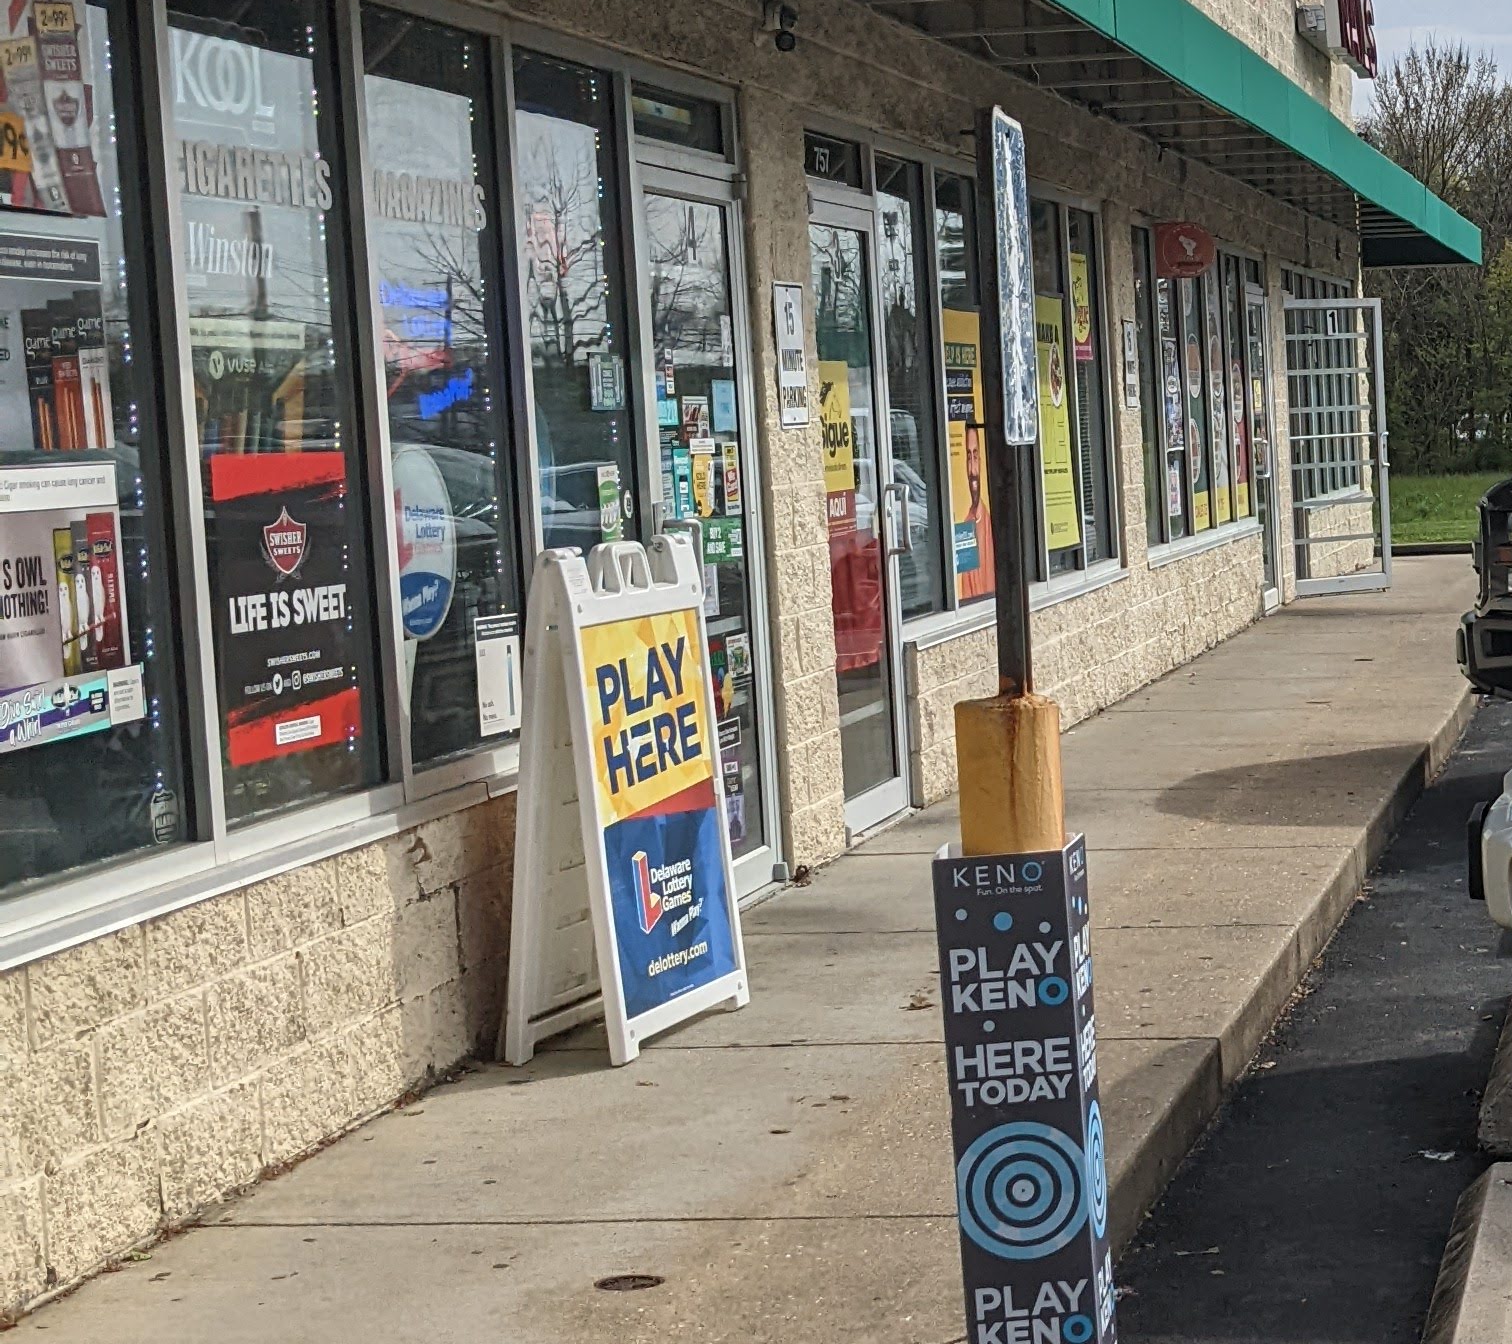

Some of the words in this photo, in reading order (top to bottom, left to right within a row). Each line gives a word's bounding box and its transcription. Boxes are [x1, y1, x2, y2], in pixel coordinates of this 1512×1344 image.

[172, 29, 275, 116] KOOL
[0, 122, 29, 159] 9¢
[814, 146, 830, 173] 757
[187, 222, 273, 278] Winston
[77, 317, 101, 337] game
[784, 301, 794, 335] 15
[26, 337, 50, 360] game
[52, 327, 76, 350] game
[782, 349, 804, 372] MINUTE
[783, 385, 807, 409] PARKING
[405, 504, 445, 523] Delaware
[829, 491, 847, 518] AQUÍ
[269, 531, 303, 547] SWISHER
[416, 523, 445, 542] Lottery
[273, 546, 301, 556] SWEETS
[15, 556, 47, 588] OWL
[0, 590, 49, 619] OTHING!
[229, 593, 268, 634] LIFE
[270, 590, 290, 628] IS
[293, 583, 346, 625] SWEET
[596, 635, 686, 726] PLAY
[604, 700, 702, 795] HERE
[650, 858, 692, 884] Delaware
[663, 874, 692, 896] Lottery
[953, 860, 1042, 889] KENO
[662, 889, 692, 911] Games
[976, 887, 992, 896] Fun.
[995, 886, 1007, 895] On
[1009, 885, 1022, 893] the
[688, 897, 704, 922] Play?
[648, 941, 708, 976] delottery.com
[949, 940, 1063, 982] PLAY
[953, 976, 1069, 1013] KENO
[955, 1037, 1072, 1080] HERE
[957, 1073, 1072, 1106] TODAY
[975, 1278, 1088, 1321] PLAY
